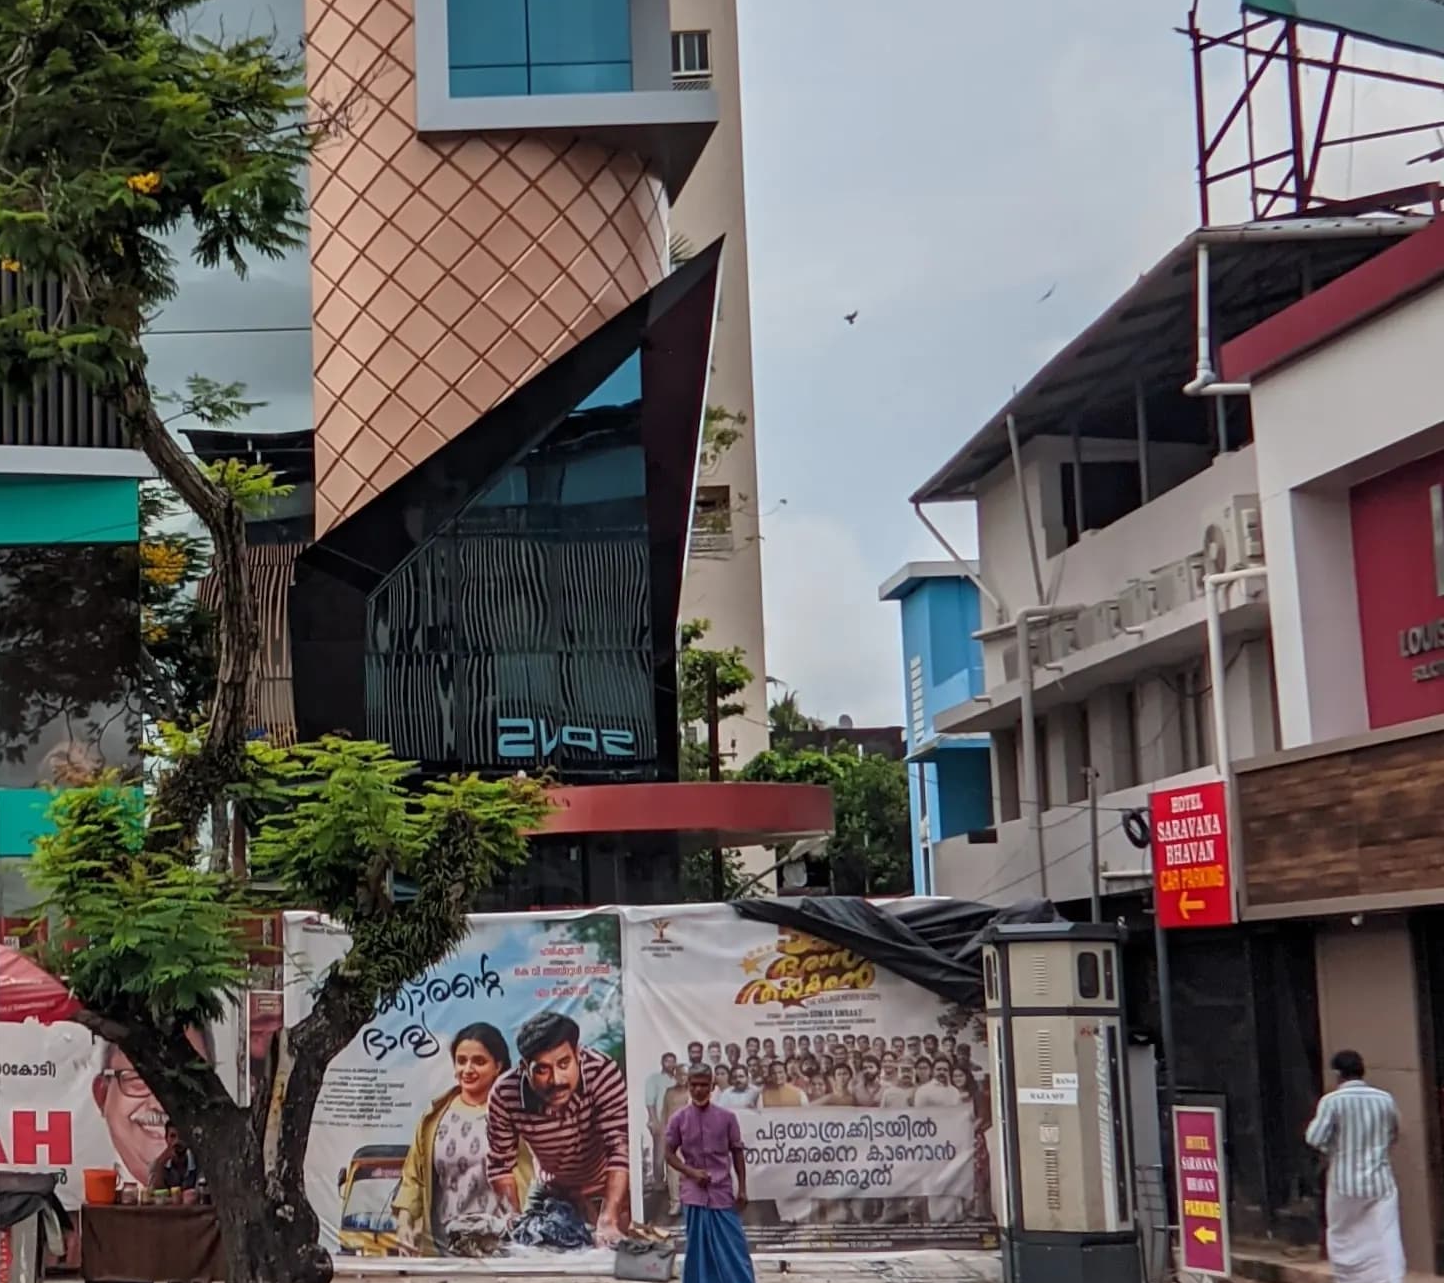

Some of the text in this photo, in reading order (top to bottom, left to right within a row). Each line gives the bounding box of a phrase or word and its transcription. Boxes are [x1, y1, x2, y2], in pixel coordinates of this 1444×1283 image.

[1170, 793, 1204, 813] HOTEL
[1156, 813, 1221, 842] SARAVANA
[1165, 840, 1215, 866] BHAVAN
[1180, 864, 1225, 889] PARKING
[362, 1011, 441, 1062] ഭാര്യ
[755, 1114, 938, 1143] പദയാത്രക്കിടയിൽ
[865, 1140, 957, 1162] കാണാൻ
[1181, 1156, 1218, 1171] SARAVANA
[794, 1163, 894, 1190] മറക്കരുത്
[1184, 1199, 1220, 1218] PARKING
